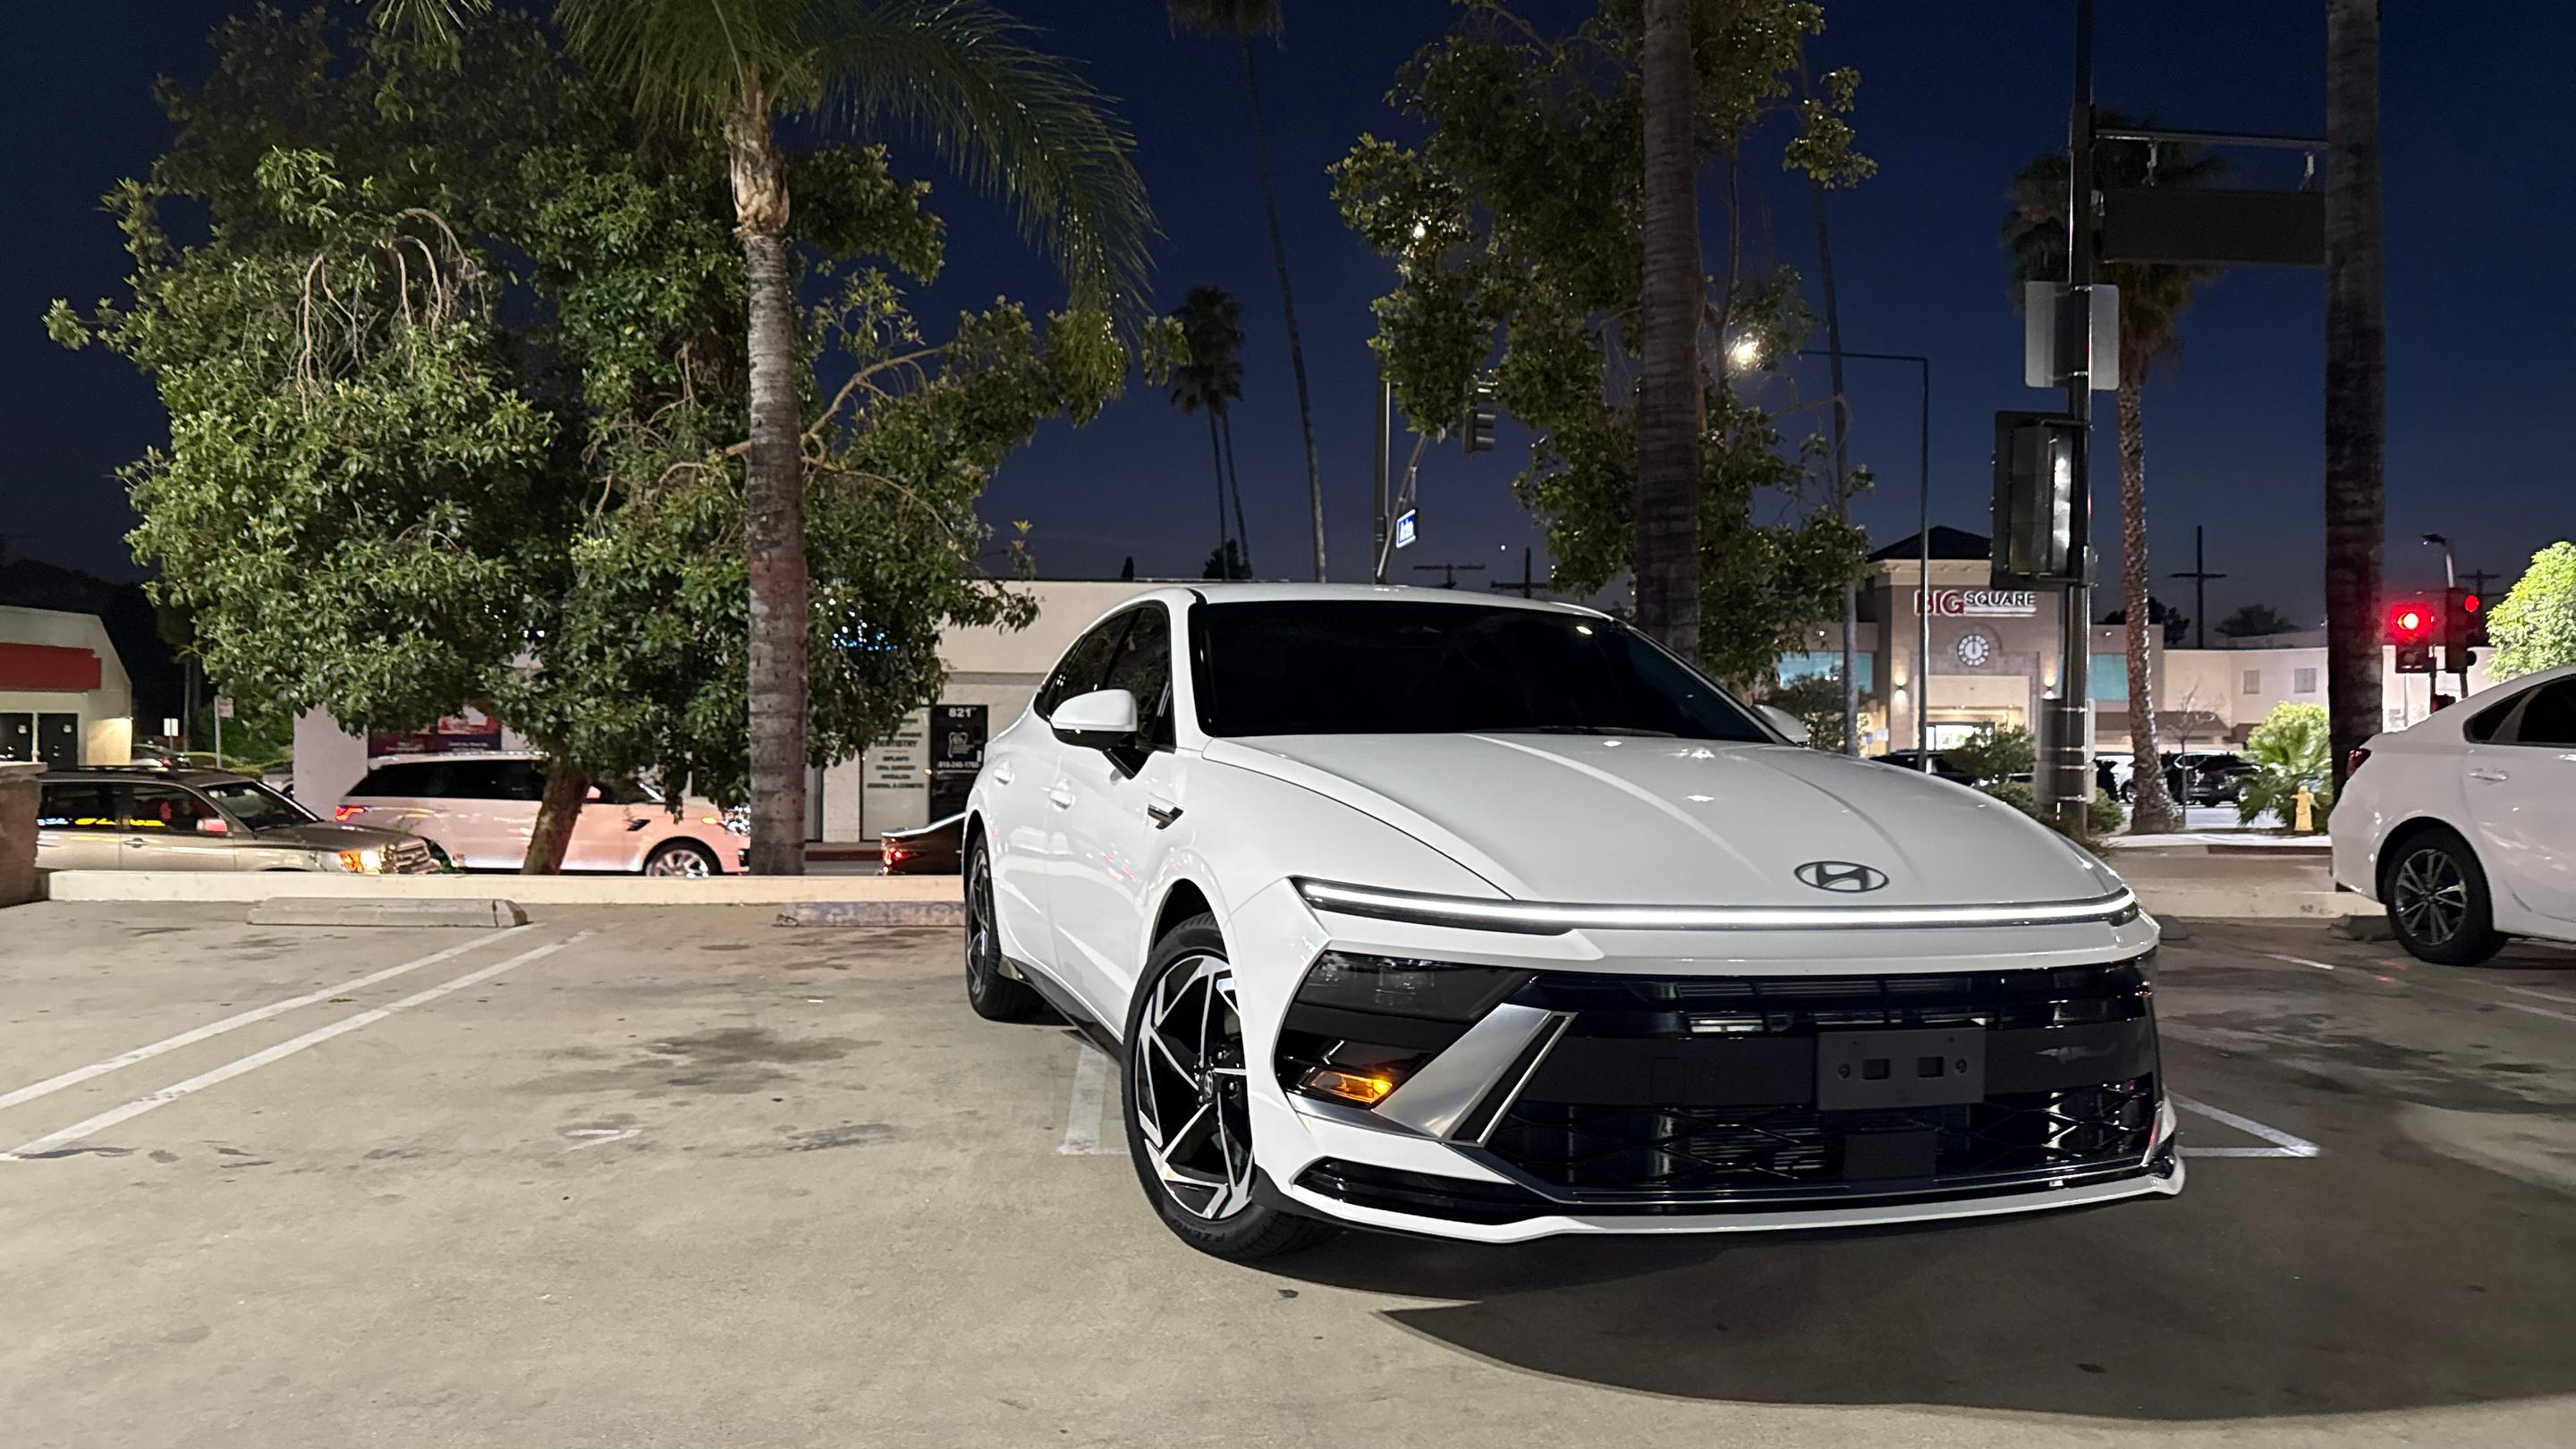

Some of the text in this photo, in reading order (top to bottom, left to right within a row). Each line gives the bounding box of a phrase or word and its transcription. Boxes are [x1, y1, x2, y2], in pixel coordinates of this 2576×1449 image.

[1914, 589, 2037, 617] BIG SQUARE
[948, 708, 971, 717] 821
